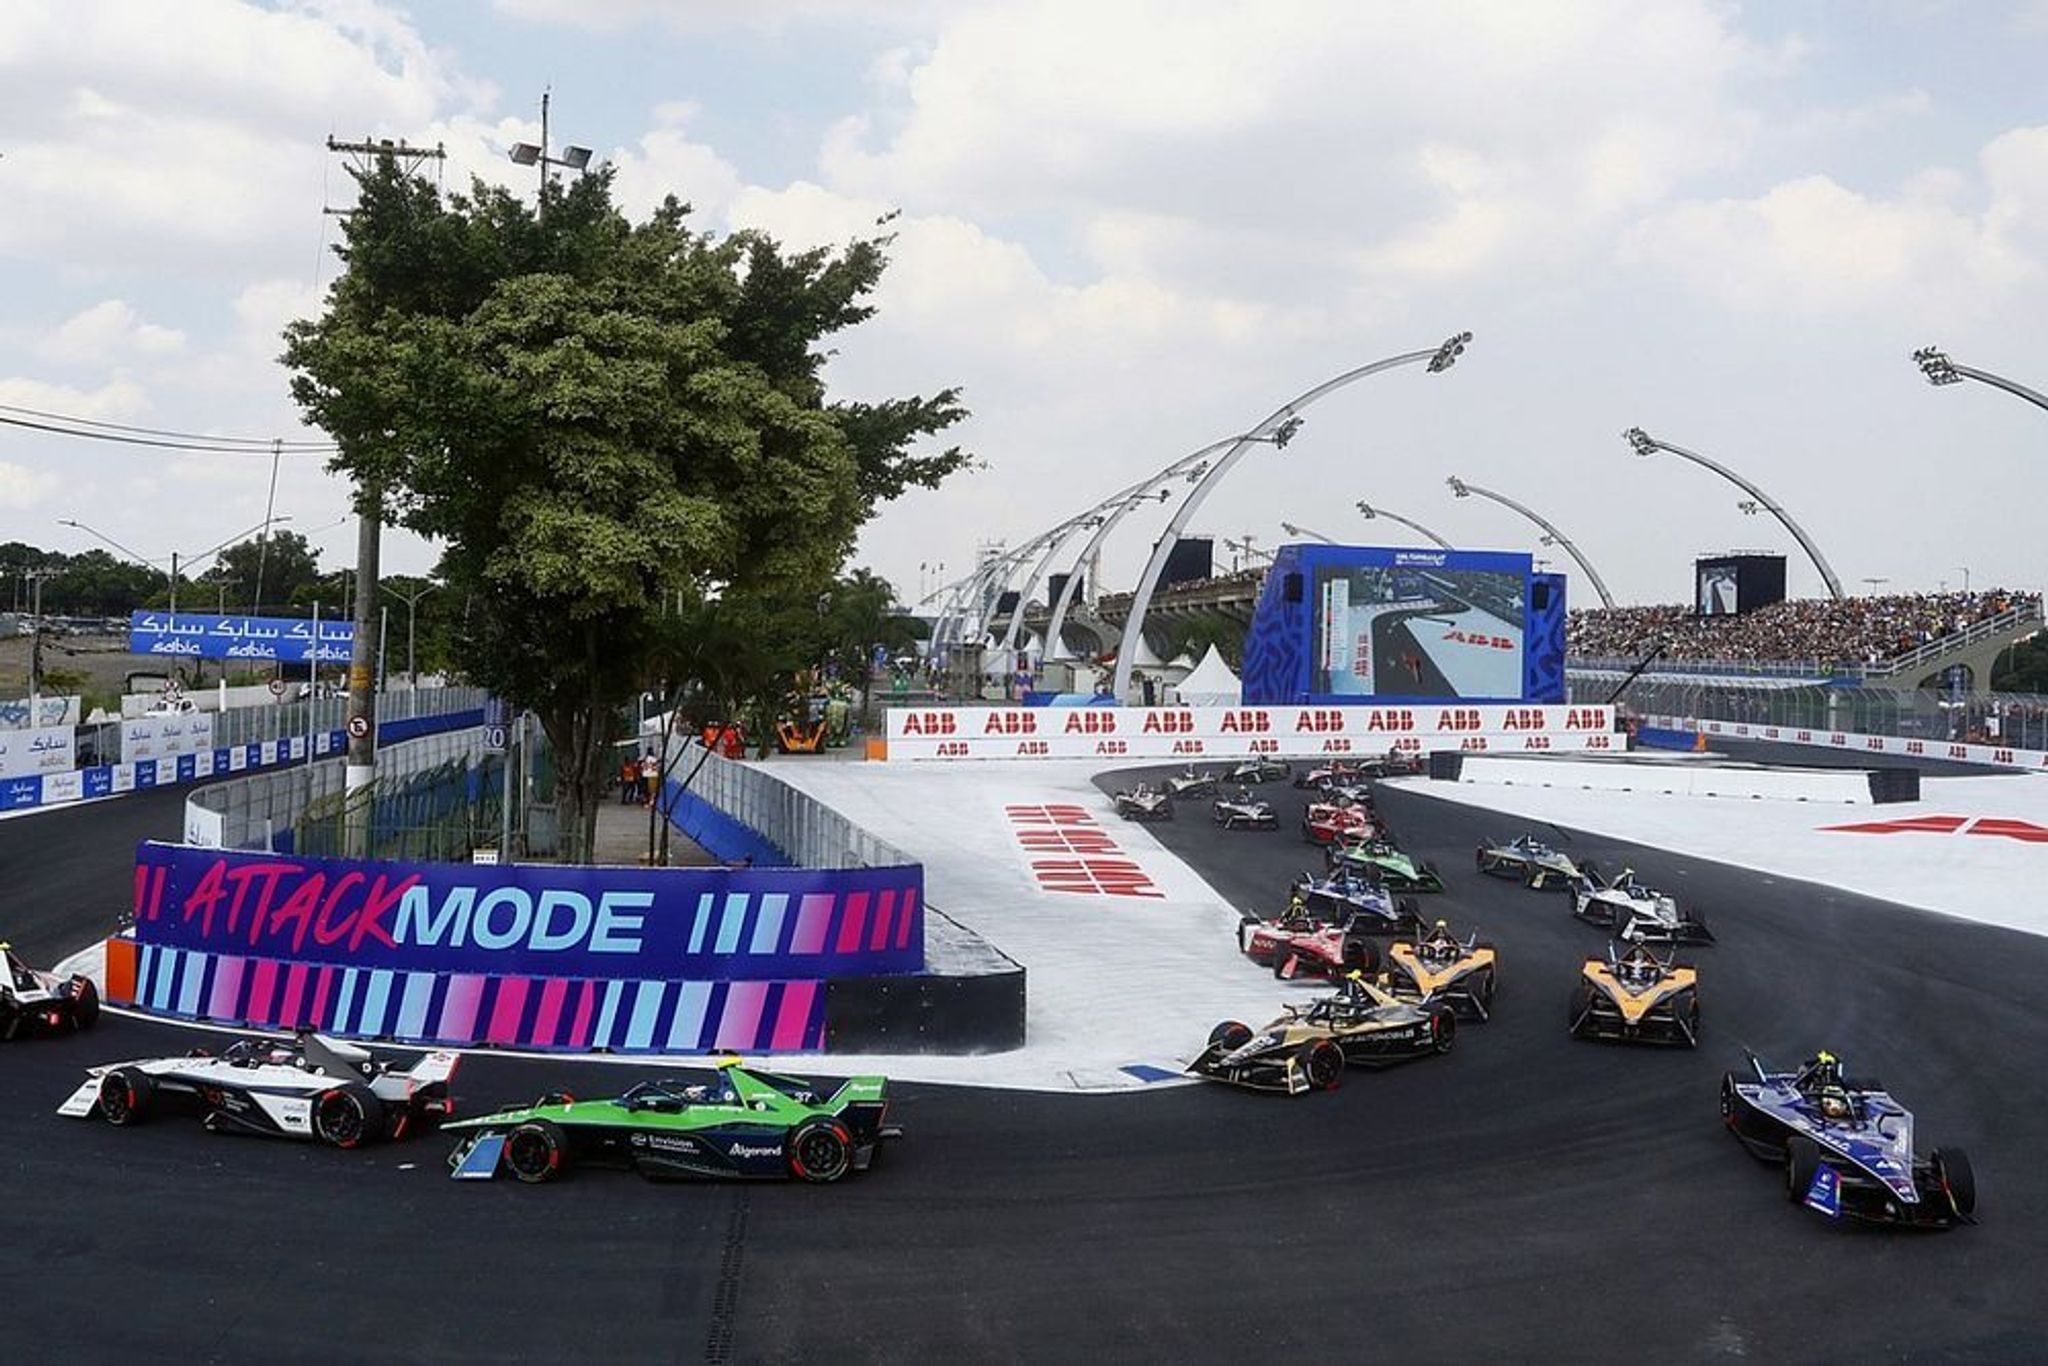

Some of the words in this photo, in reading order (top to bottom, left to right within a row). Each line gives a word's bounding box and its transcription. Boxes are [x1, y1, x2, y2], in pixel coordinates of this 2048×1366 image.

[903, 712, 957, 735] ABB
[984, 712, 1037, 734] ABB
[1065, 711, 1116, 734] ABB
[1143, 711, 1194, 733] ABB
[1221, 711, 1271, 732] ABB
[1297, 710, 1344, 732] ABB
[1368, 710, 1414, 731] ABB
[1438, 710, 1482, 730] ABB
[1503, 709, 1546, 730] ABB
[1565, 709, 1606, 729] ABB
[936, 742, 969, 756] ABB
[1017, 741, 1048, 754] ABB
[1096, 740, 1127, 754] ABB
[1172, 740, 1203, 753] ABB
[1249, 739, 1280, 752] ABB
[1322, 739, 1351, 752] ABB
[1460, 738, 1487, 750] ABB
[1525, 737, 1550, 749] ABB
[1585, 736, 1609, 749] ABB
[184, 858, 421, 953] ATTACK
[392, 885, 655, 952] MODE
